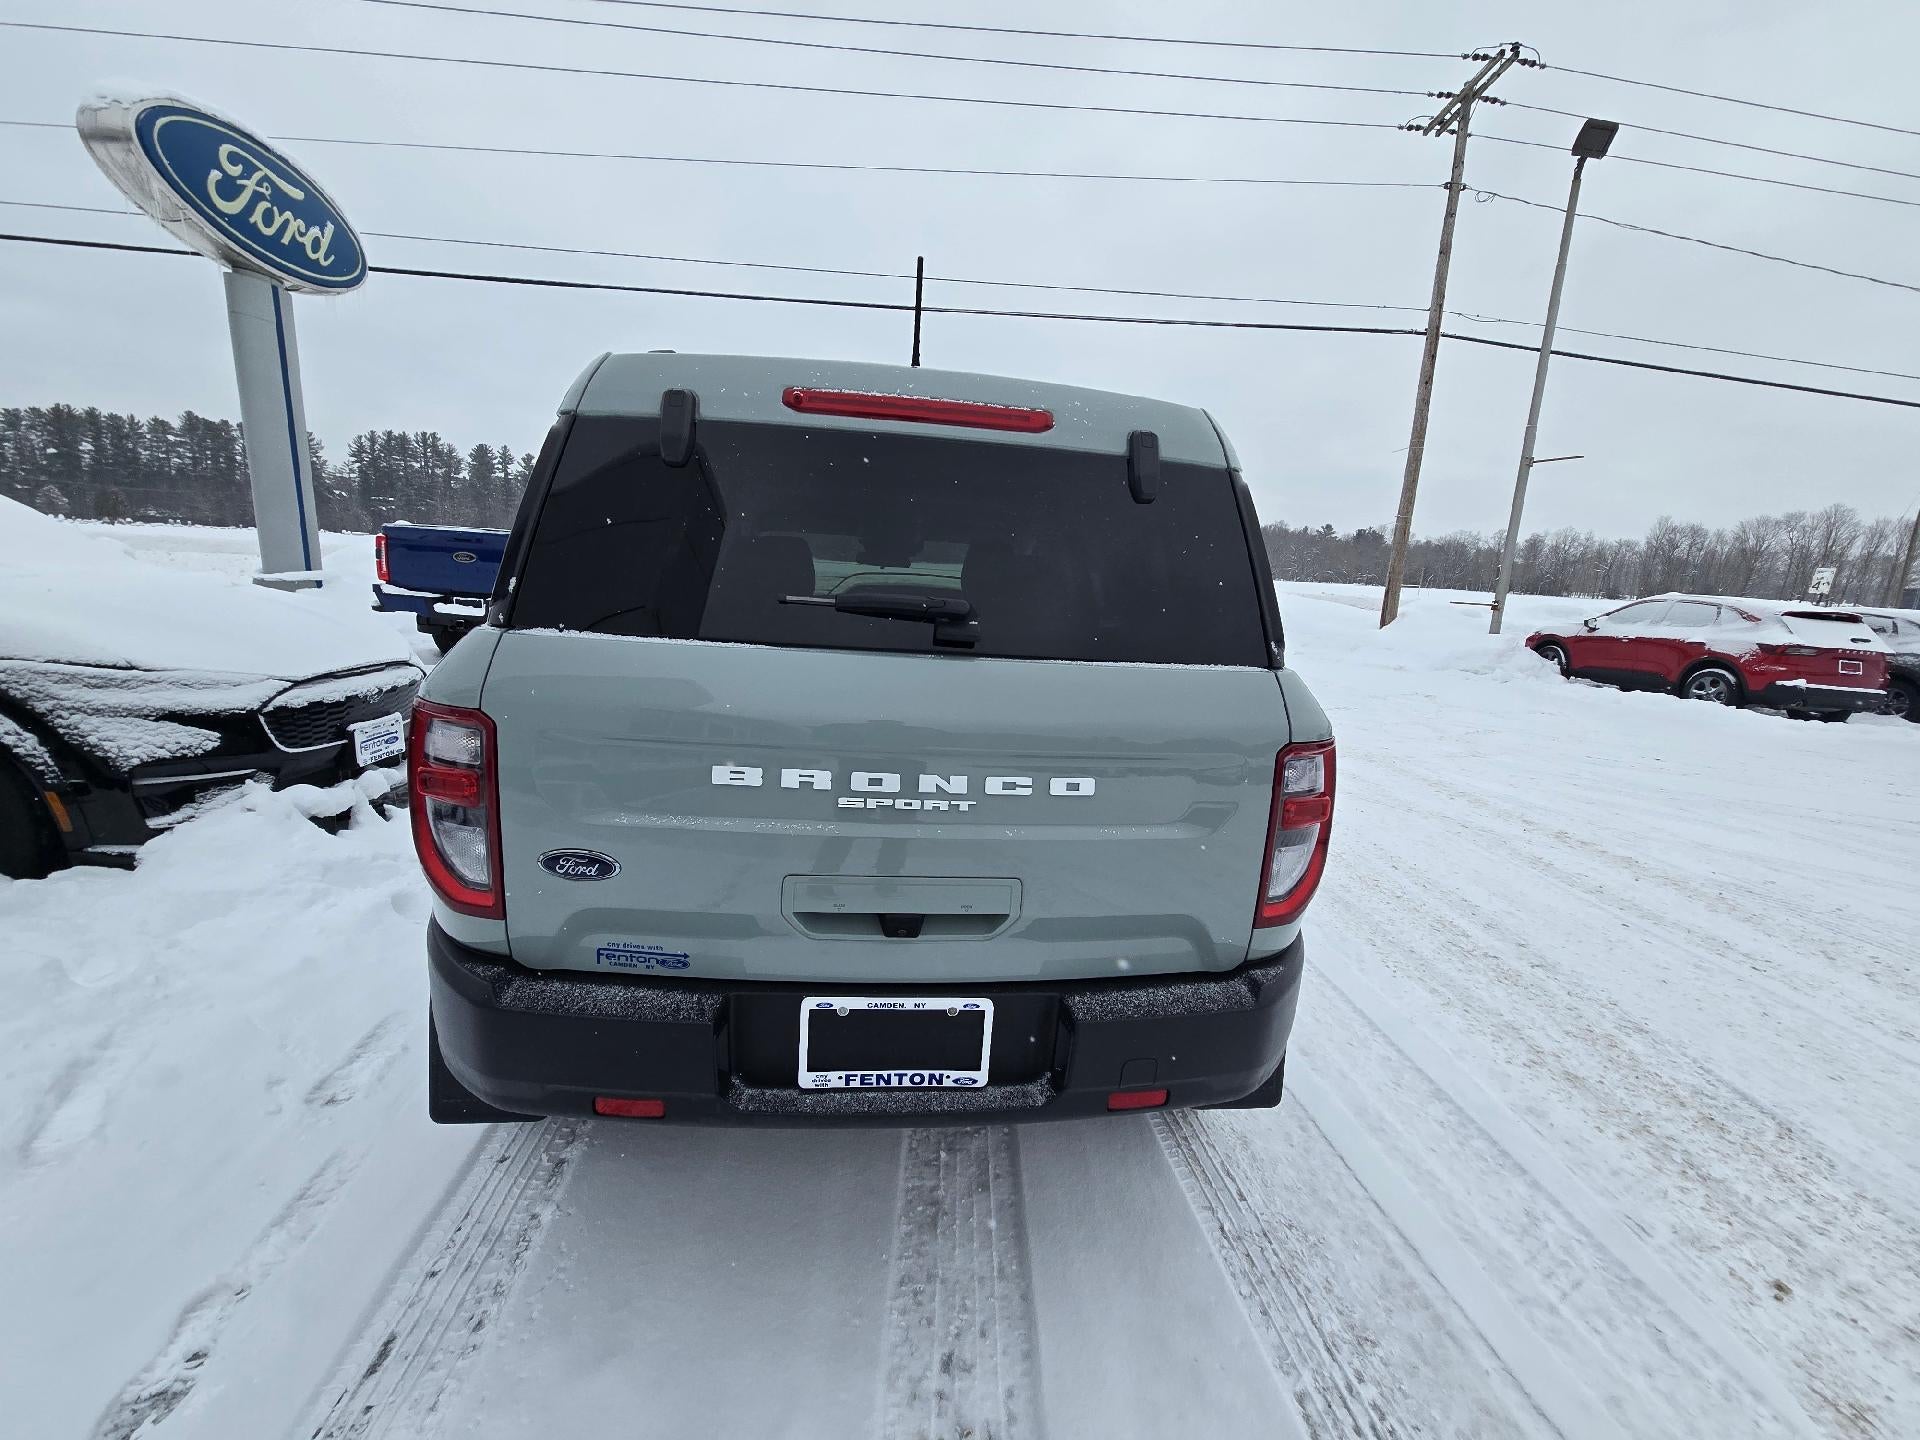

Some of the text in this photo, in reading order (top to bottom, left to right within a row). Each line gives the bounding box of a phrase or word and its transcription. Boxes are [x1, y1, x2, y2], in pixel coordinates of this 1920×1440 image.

[207, 143, 336, 267] Ford
[370, 749, 395, 763] FENTON
[711, 765, 1096, 796] BRONCO
[837, 797, 977, 811] SPORT
[555, 857, 599, 875] Ford
[597, 948, 660, 965] Fenton
